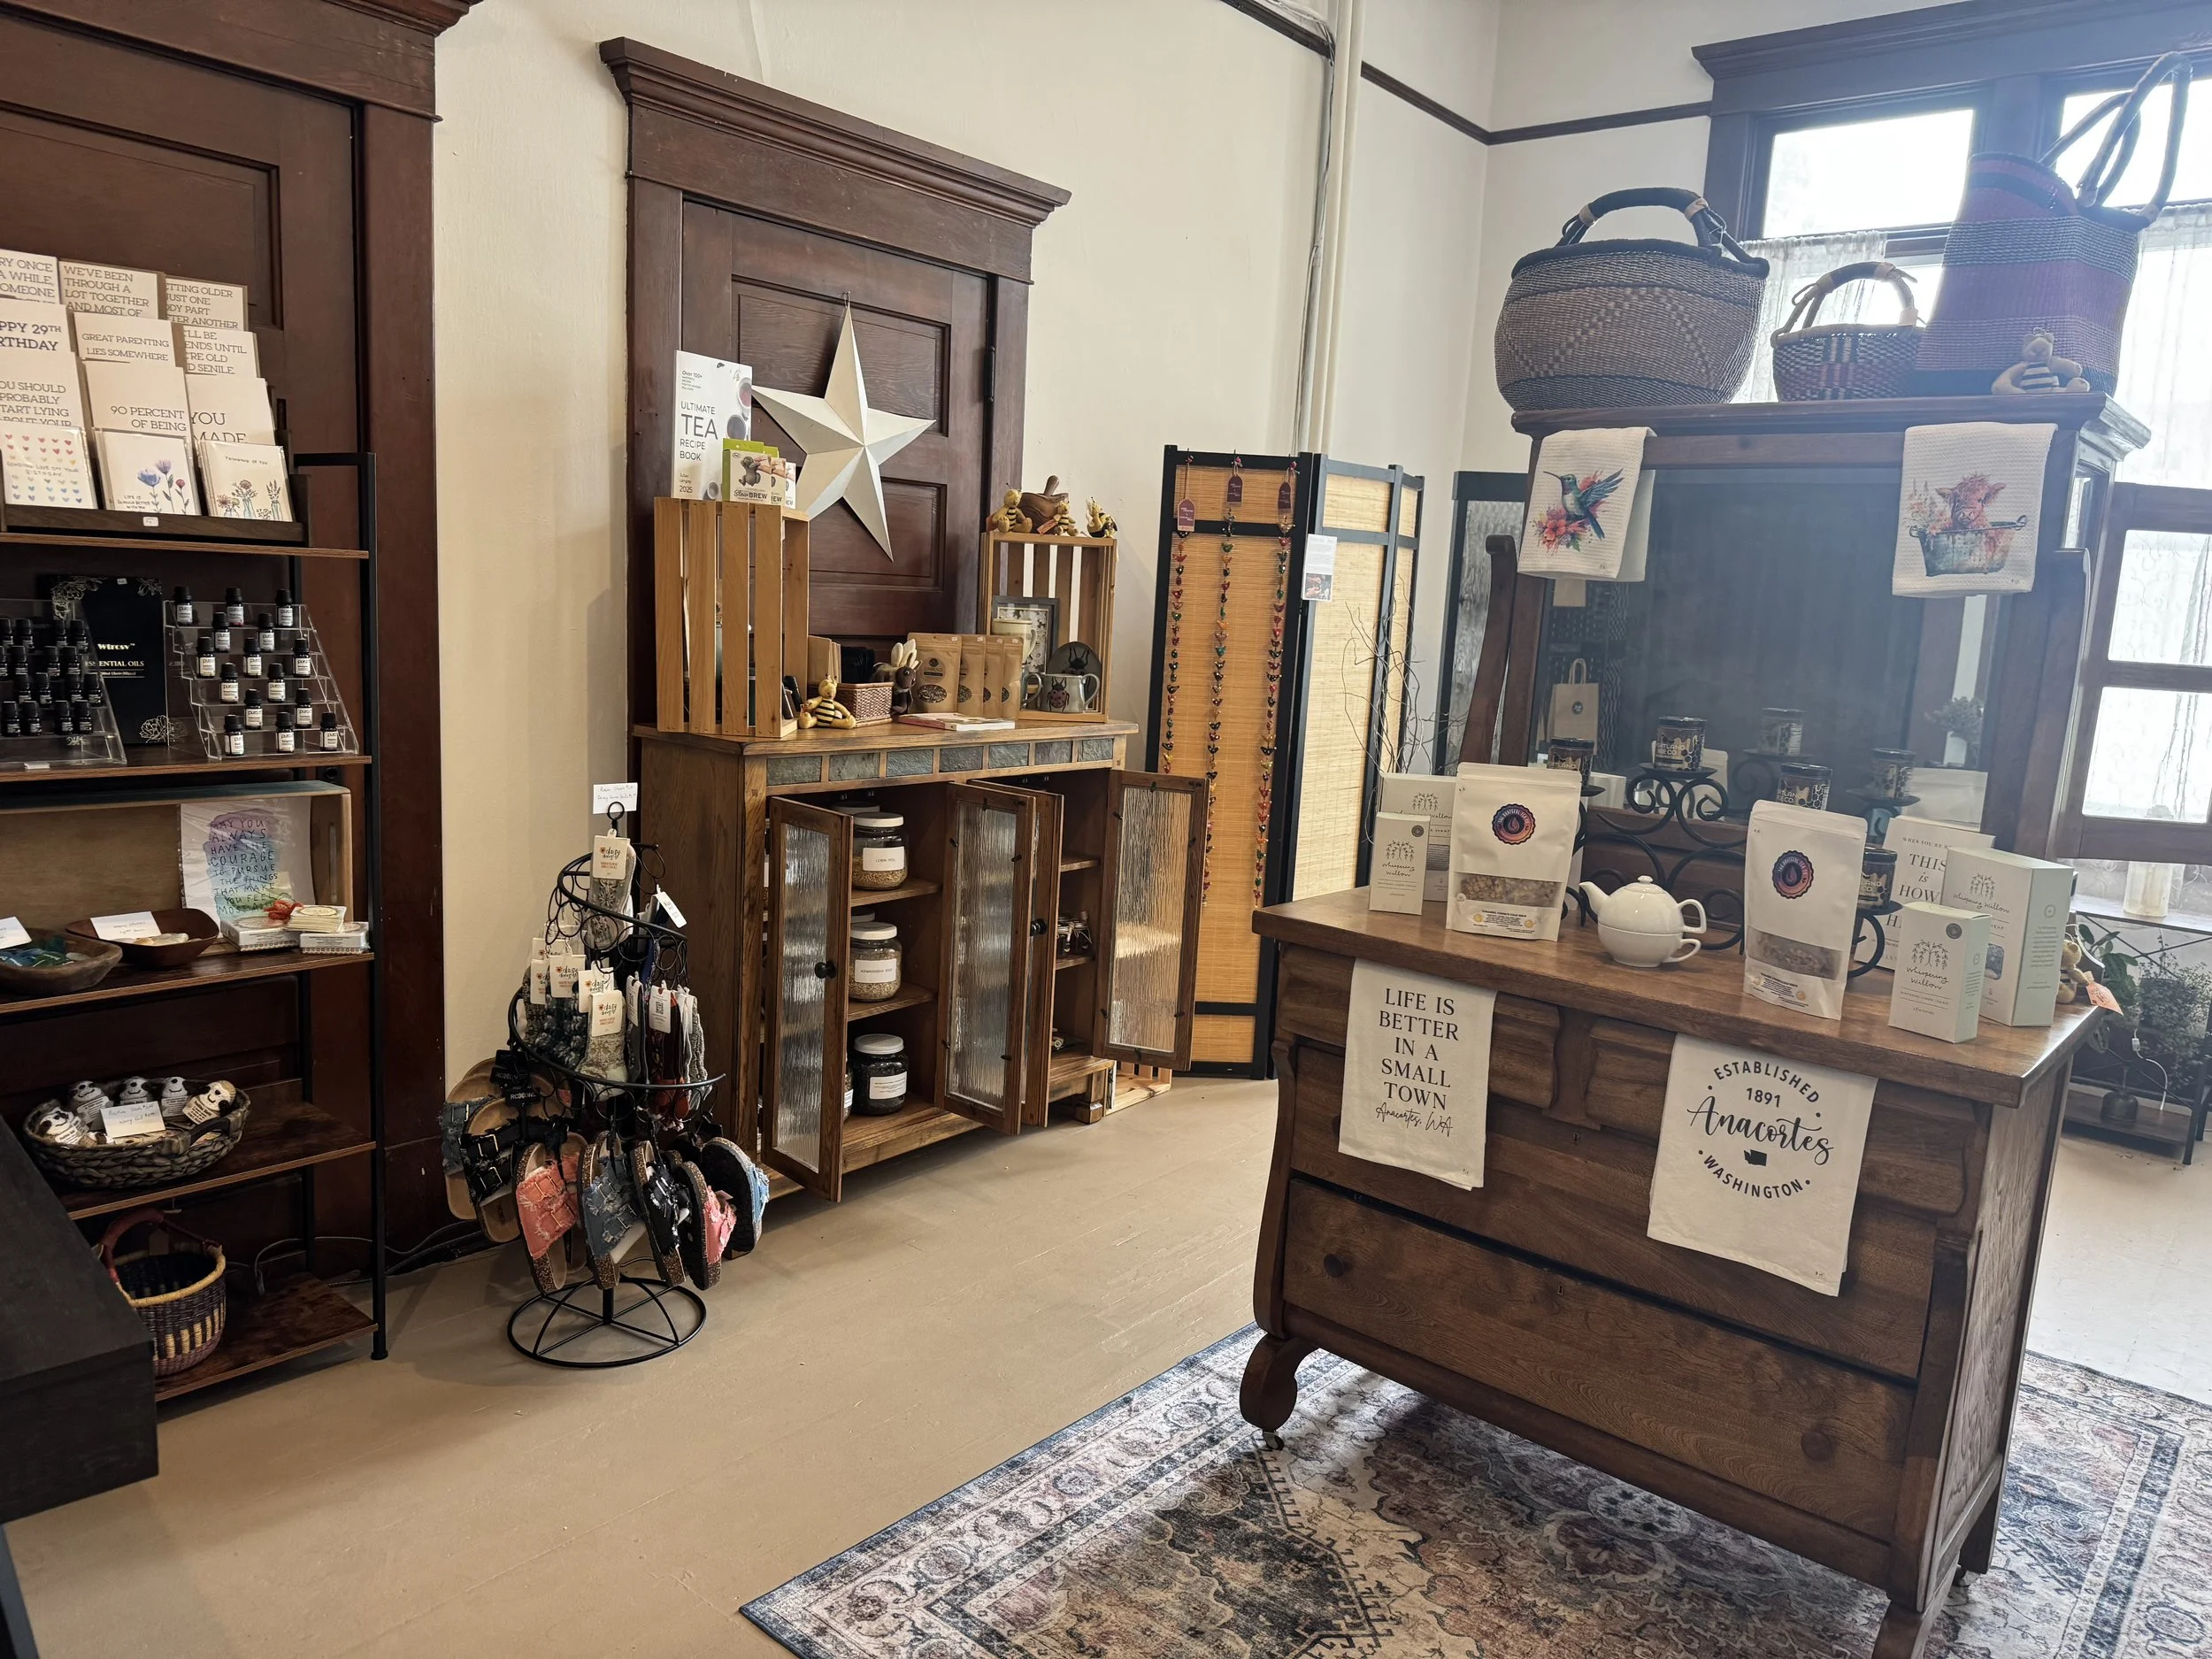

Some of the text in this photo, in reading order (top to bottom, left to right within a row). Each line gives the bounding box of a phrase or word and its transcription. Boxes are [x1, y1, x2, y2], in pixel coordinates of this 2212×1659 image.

[17, 260, 53, 273] ONCE
[10, 272, 55, 286] WHILE,
[64, 265, 134, 282] WE'VE BEEN
[64, 278, 120, 292] THROUGH
[65, 289, 149, 307] LOT TOGETHER
[201, 287, 233, 297] OLDER
[189, 296, 211, 305] ONE
[66, 302, 92, 311] AND
[95, 305, 126, 316] MOST
[185, 305, 211, 315] PART
[32, 324, 62, 335] 29TH
[192, 318, 238, 328] ANOTHER
[81, 334, 170, 348] GREAT PARENTING
[204, 331, 217, 340] BE
[108, 349, 168, 361] SOMEWHERE
[214, 343, 247, 354] UNTIL
[206, 354, 227, 363] OLD
[18, 382, 66, 393] SHOULD
[0, 393, 60, 404] PROBABLY
[34, 407, 69, 417] LYING
[130, 406, 184, 419] PERCENT
[680, 400, 716, 415] ULTIMATE
[190, 412, 226, 425] YOU
[132, 419, 187, 432] OF BEING
[680, 413, 718, 440] TEA
[680, 438, 705, 450] RECIPE
[680, 450, 702, 461] BOOK
[679, 485, 693, 494] 2025
[240, 819, 264, 828] YOU
[212, 829, 266, 842] ALWAYS
[211, 843, 239, 854] HAVE
[210, 850, 274, 867] COURAGE
[1909, 853, 1947, 872] THIS
[232, 864, 275, 875] PURSUE
[1919, 872, 1929, 883] is
[213, 883, 274, 895] THAT MAKE
[1899, 885, 1941, 902] HOW
[226, 893, 274, 904] YOU FEEL
[1907, 966, 1949, 985] Whispering
[1911, 979, 1942, 990] Willow
[1385, 988, 1455, 1016] LIFE IS
[1379, 1010, 1459, 1041] BETTER
[1394, 1037, 1439, 1061] IN A
[1381, 1058, 1451, 1088] SMALL
[1713, 1060, 1820, 1104] ESTABLISHED
[1384, 1081, 1447, 1111] TOWN
[1746, 1087, 1781, 1108] 1891
[1425, 1111, 1454, 1138] WA
[1686, 1095, 1834, 1166] Anacortes
[1703, 1154, 1804, 1199] WASHINGTON
